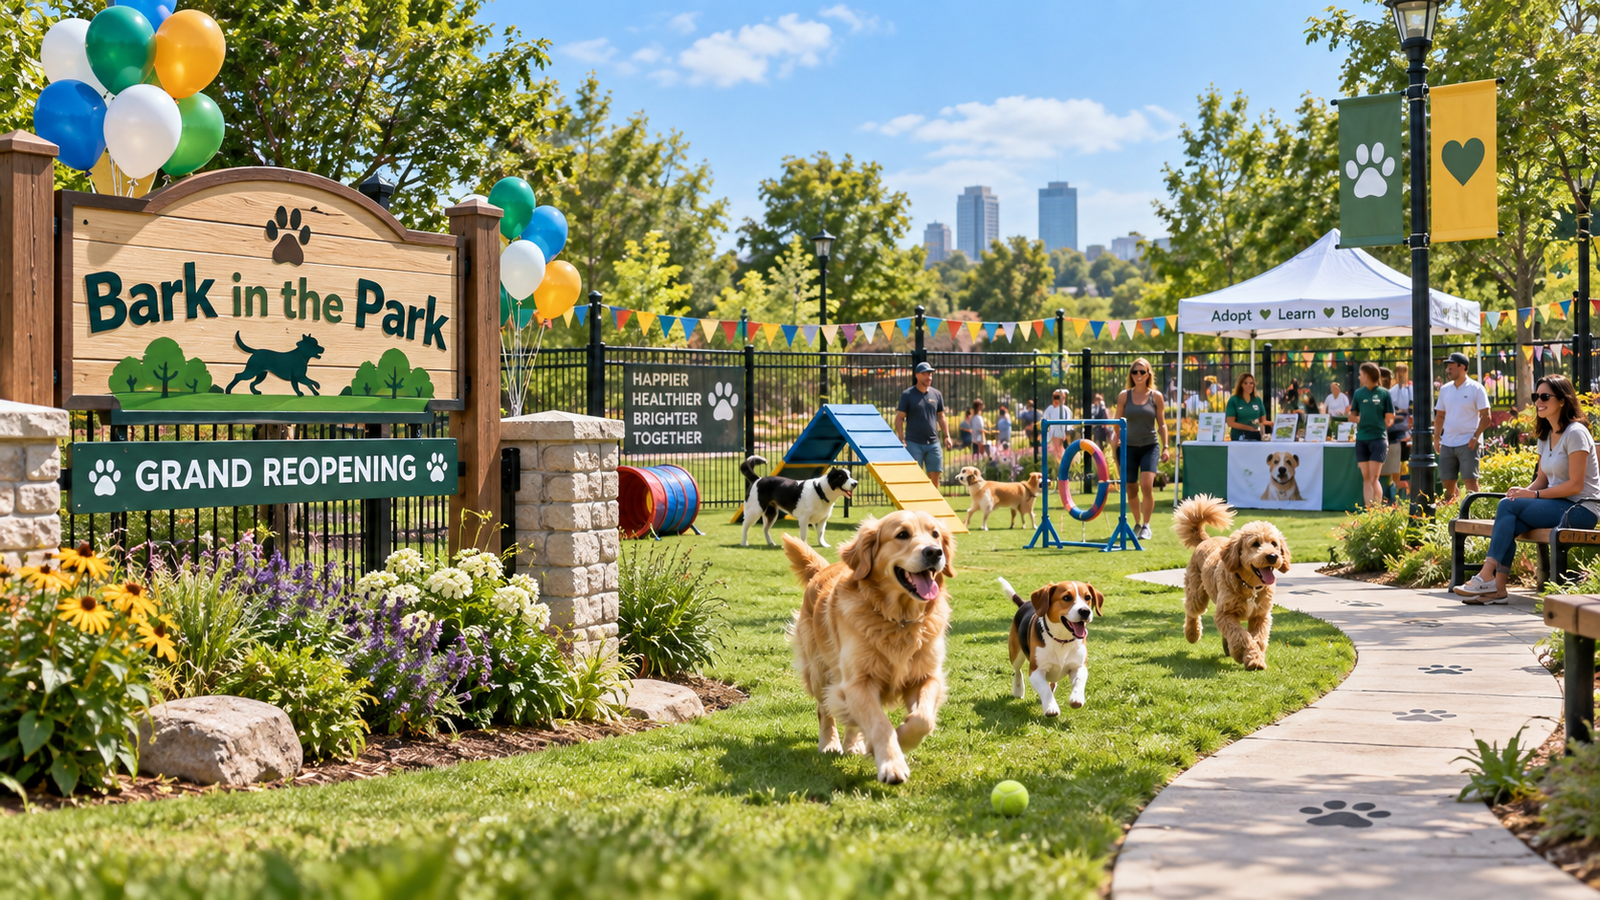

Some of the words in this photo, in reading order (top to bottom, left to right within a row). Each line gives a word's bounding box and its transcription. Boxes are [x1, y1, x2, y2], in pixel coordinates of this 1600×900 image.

[84, 261, 219, 334] Bark
[231, 271, 268, 317] in
[280, 276, 344, 324] the
[355, 277, 450, 351] Park
[1211, 309, 1253, 325] Adopt
[1278, 307, 1316, 320] Learn
[1341, 305, 1390, 320] Belong
[632, 372, 689, 387] HAPPIER
[632, 392, 702, 406] HEALTHIER
[633, 412, 698, 425] BRIGHTER
[633, 431, 702, 445] TOGETHER
[135, 458, 252, 492] GRAND
[263, 454, 417, 487] REOPENING
